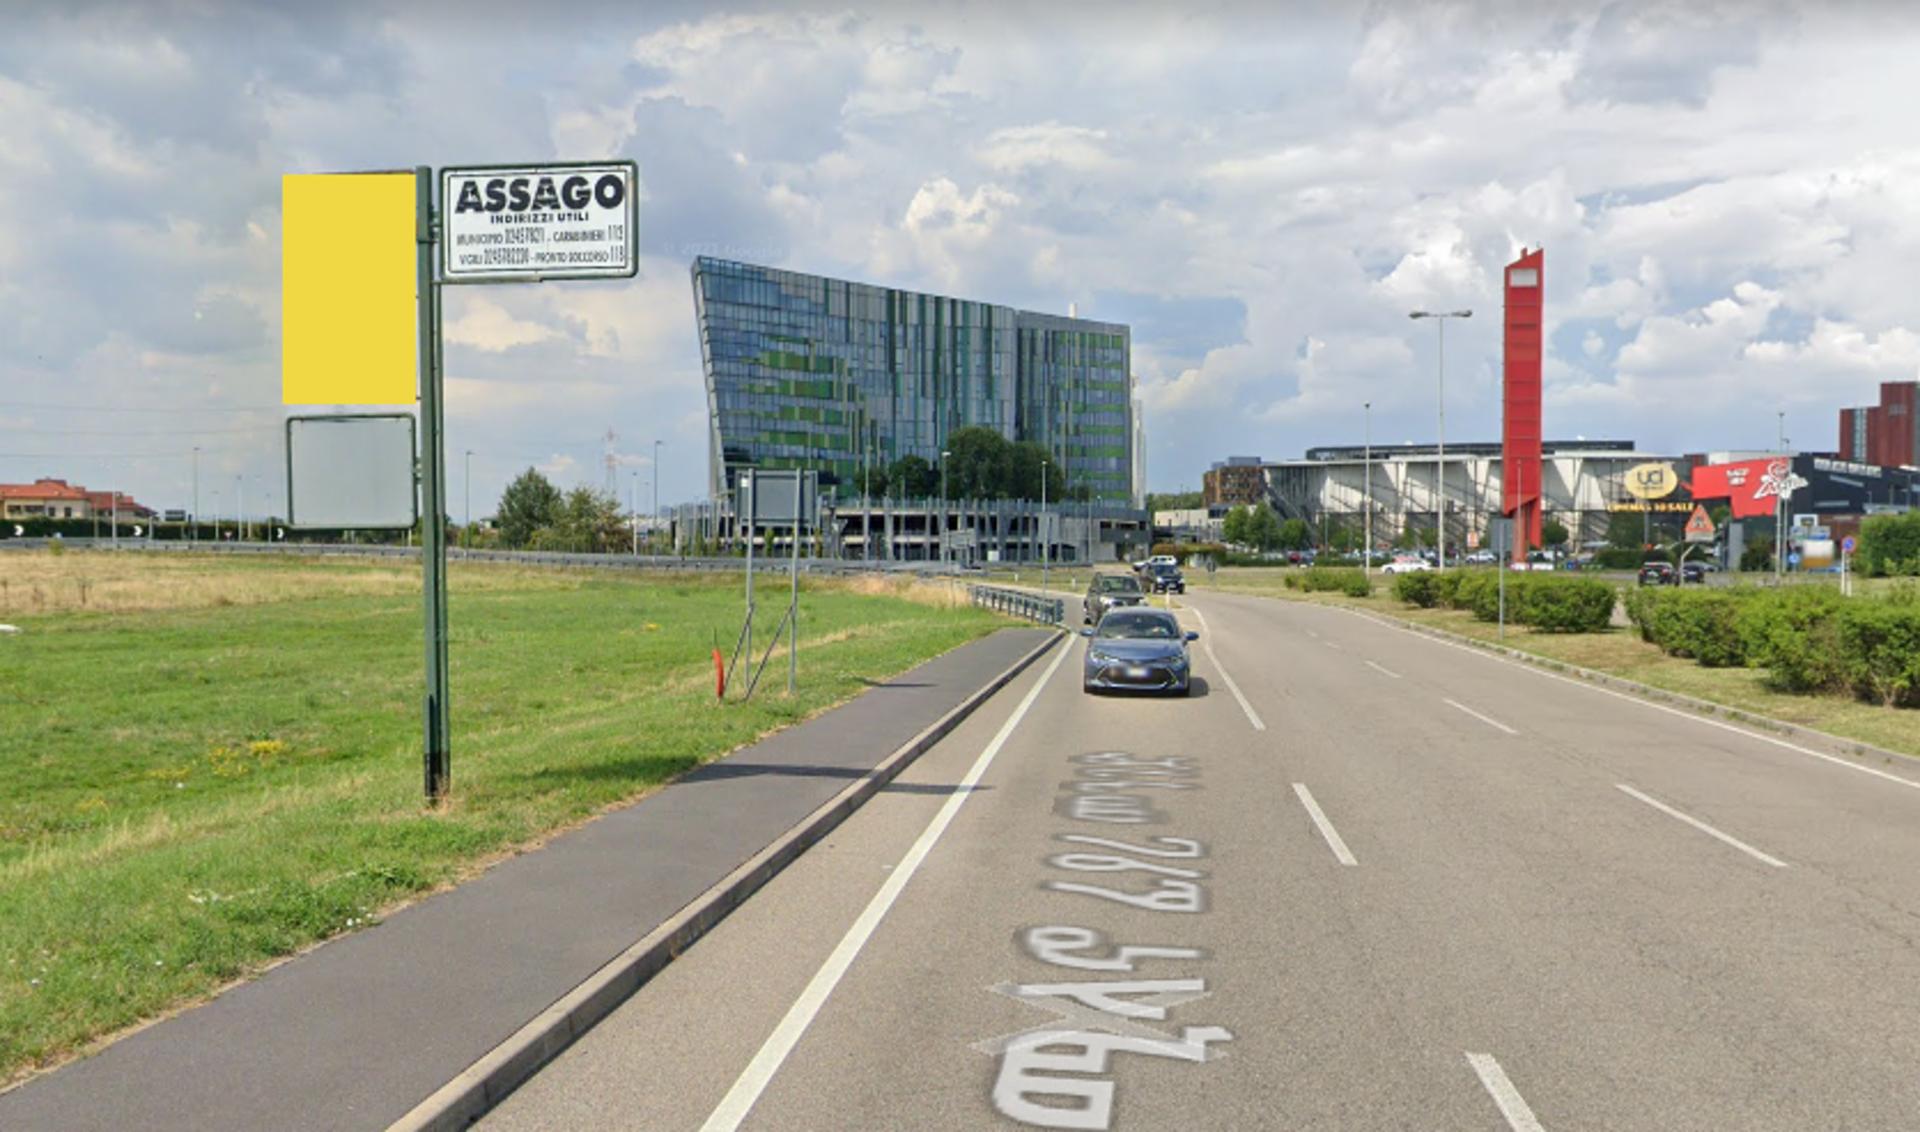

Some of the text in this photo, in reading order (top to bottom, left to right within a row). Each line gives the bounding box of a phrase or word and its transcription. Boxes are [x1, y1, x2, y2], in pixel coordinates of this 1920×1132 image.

[455, 174, 624, 214] ASSAGO
[490, 212, 589, 224] INDIRIZZI UTILI
